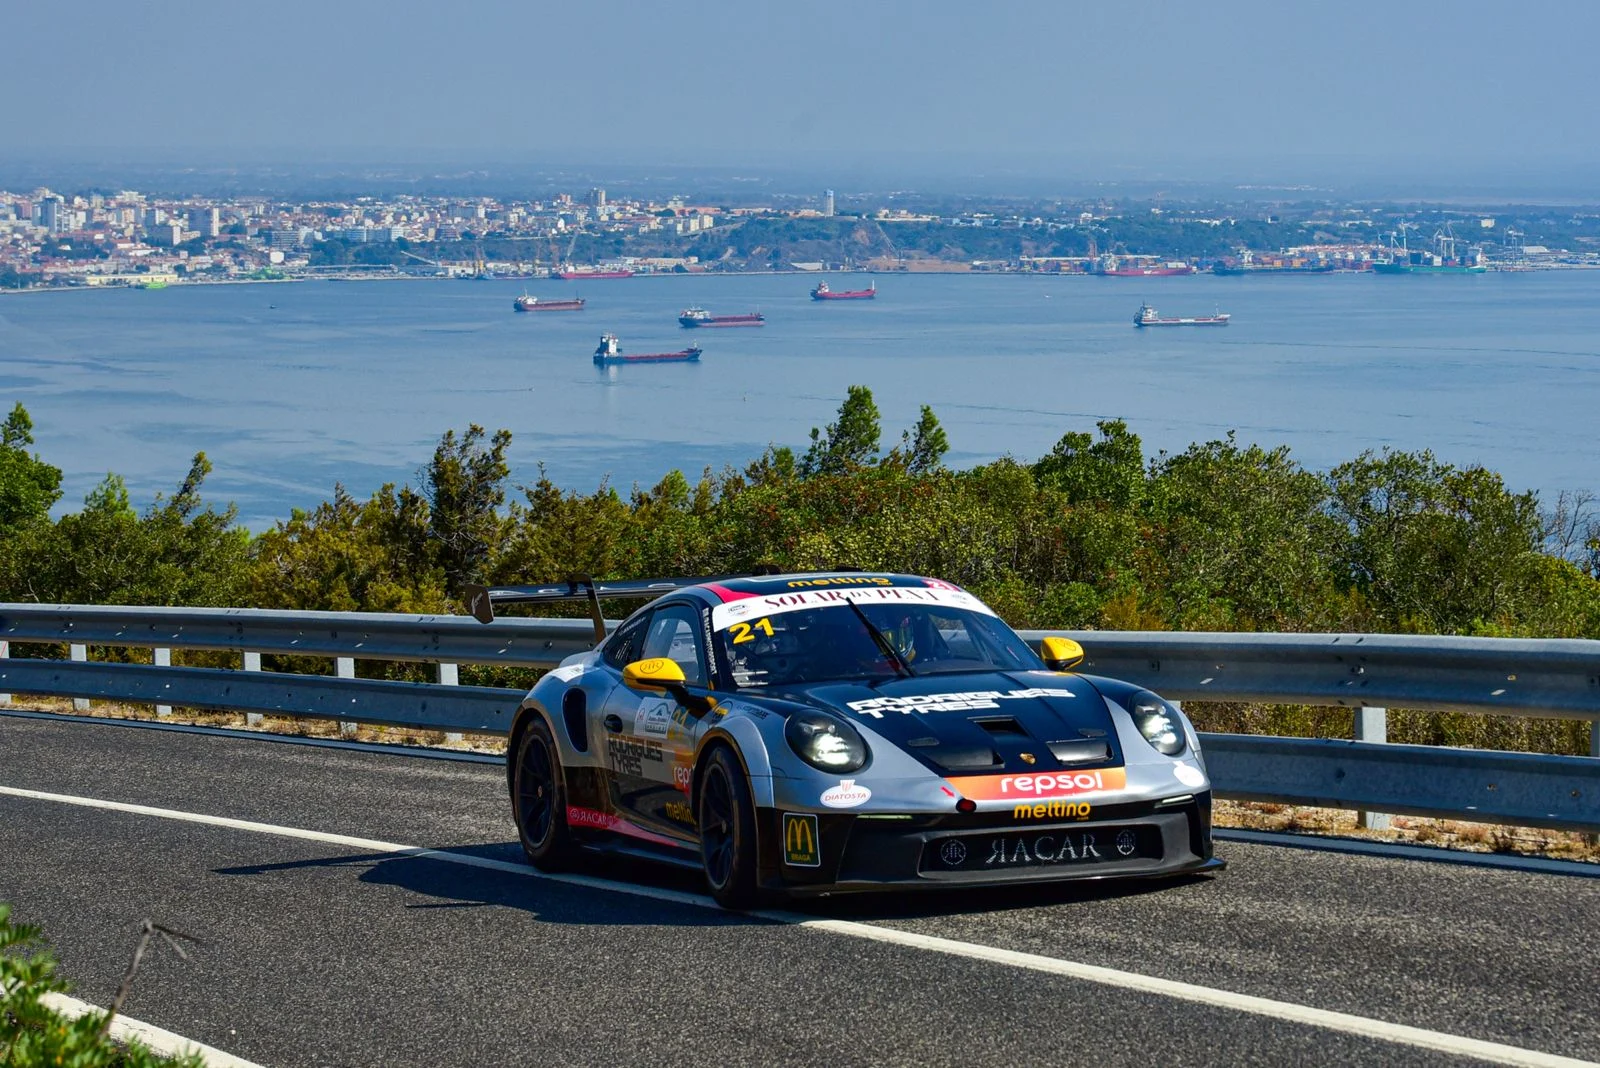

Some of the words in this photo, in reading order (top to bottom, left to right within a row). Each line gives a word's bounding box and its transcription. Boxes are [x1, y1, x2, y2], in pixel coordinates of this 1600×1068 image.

[787, 577, 889, 588] meltino
[764, 590, 848, 609] SOLAR
[729, 617, 775, 645] 21
[846, 687, 1076, 711] RODRIGUES
[858, 699, 1000, 719] TYRES
[608, 734, 663, 763] RODRIGUES
[609, 752, 643, 776] TYRES
[1000, 771, 1103, 795] repsol
[824, 792, 867, 802] DIATOSTA
[1013, 800, 1091, 819] meltino
